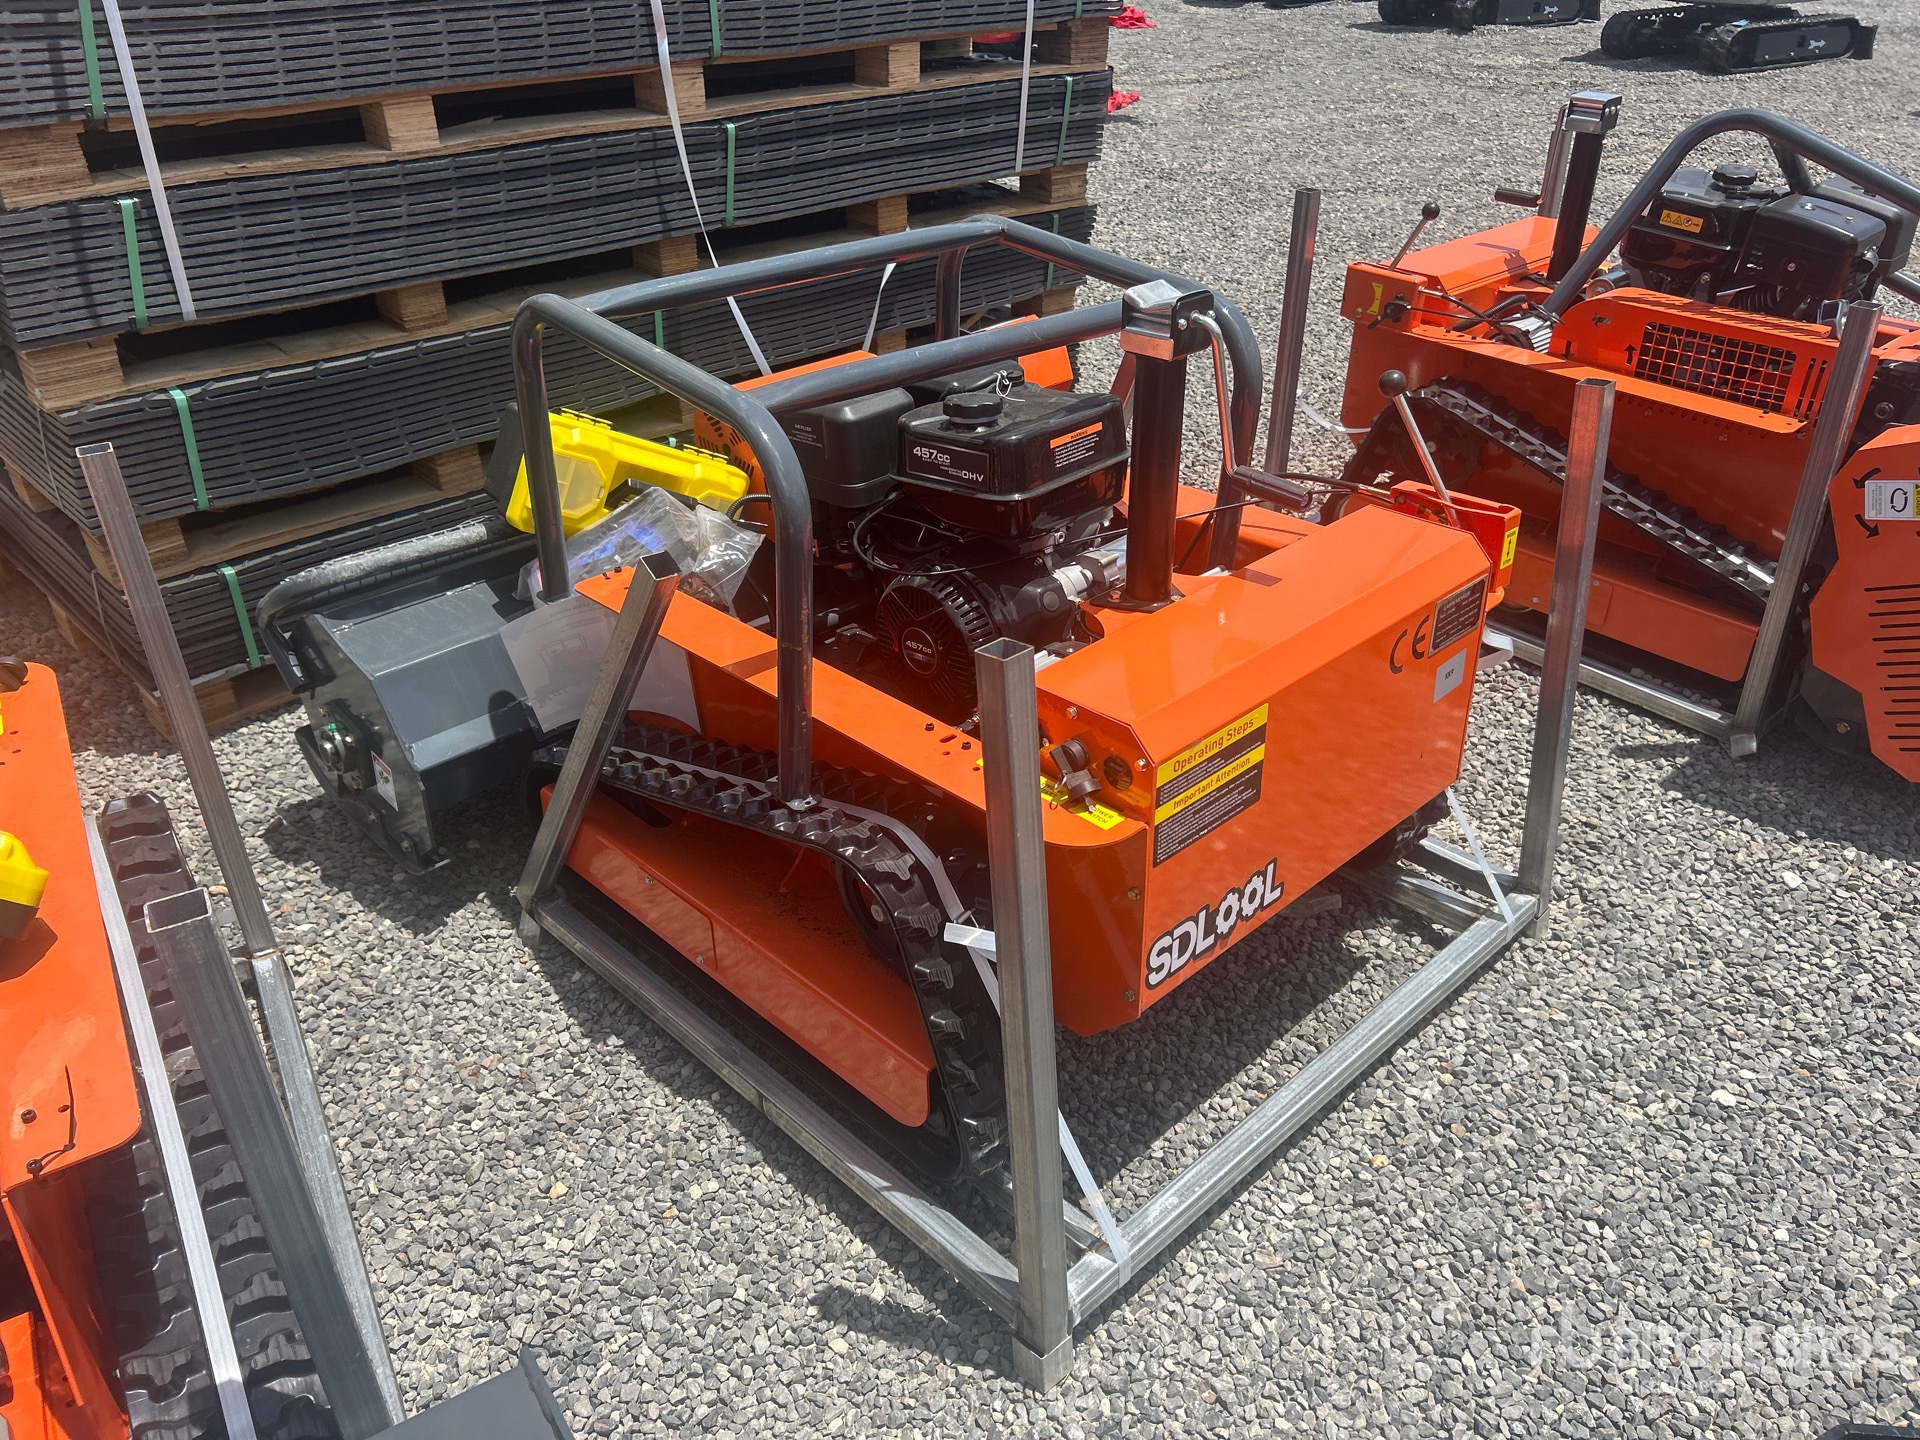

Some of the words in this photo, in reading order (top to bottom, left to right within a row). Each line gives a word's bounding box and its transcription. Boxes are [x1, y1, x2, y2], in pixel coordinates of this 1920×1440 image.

[913, 446, 951, 463] 457cc
[961, 470, 984, 482] OHV
[905, 640, 932, 654] 457cc
[1173, 735, 1224, 774] Operating
[1226, 718, 1254, 742] Steps
[1173, 779, 1214, 810] Important
[1215, 757, 1251, 785] Attention
[1094, 807, 1115, 820] OWER
[1147, 861, 1283, 987] SDLOOL
